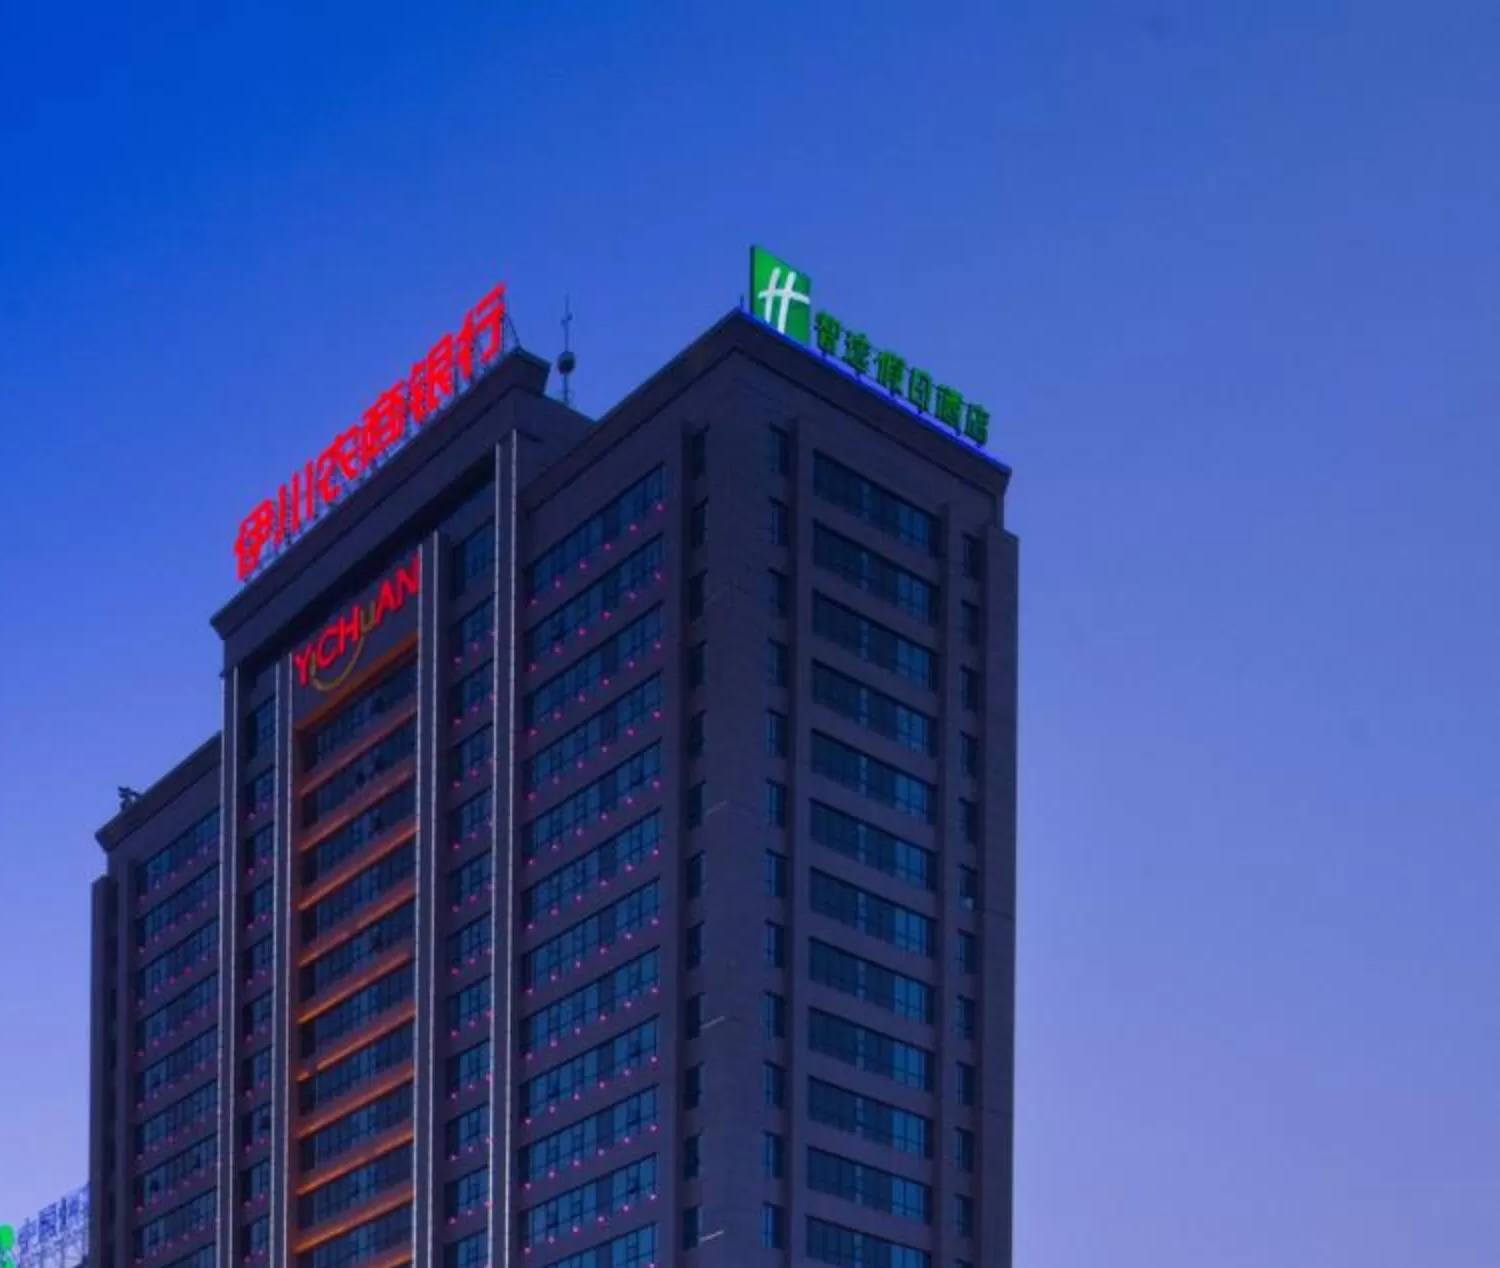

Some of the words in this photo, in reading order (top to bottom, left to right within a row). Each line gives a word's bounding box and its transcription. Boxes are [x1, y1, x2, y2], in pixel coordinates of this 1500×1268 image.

[233, 281, 505, 581] 伊川农商银行
